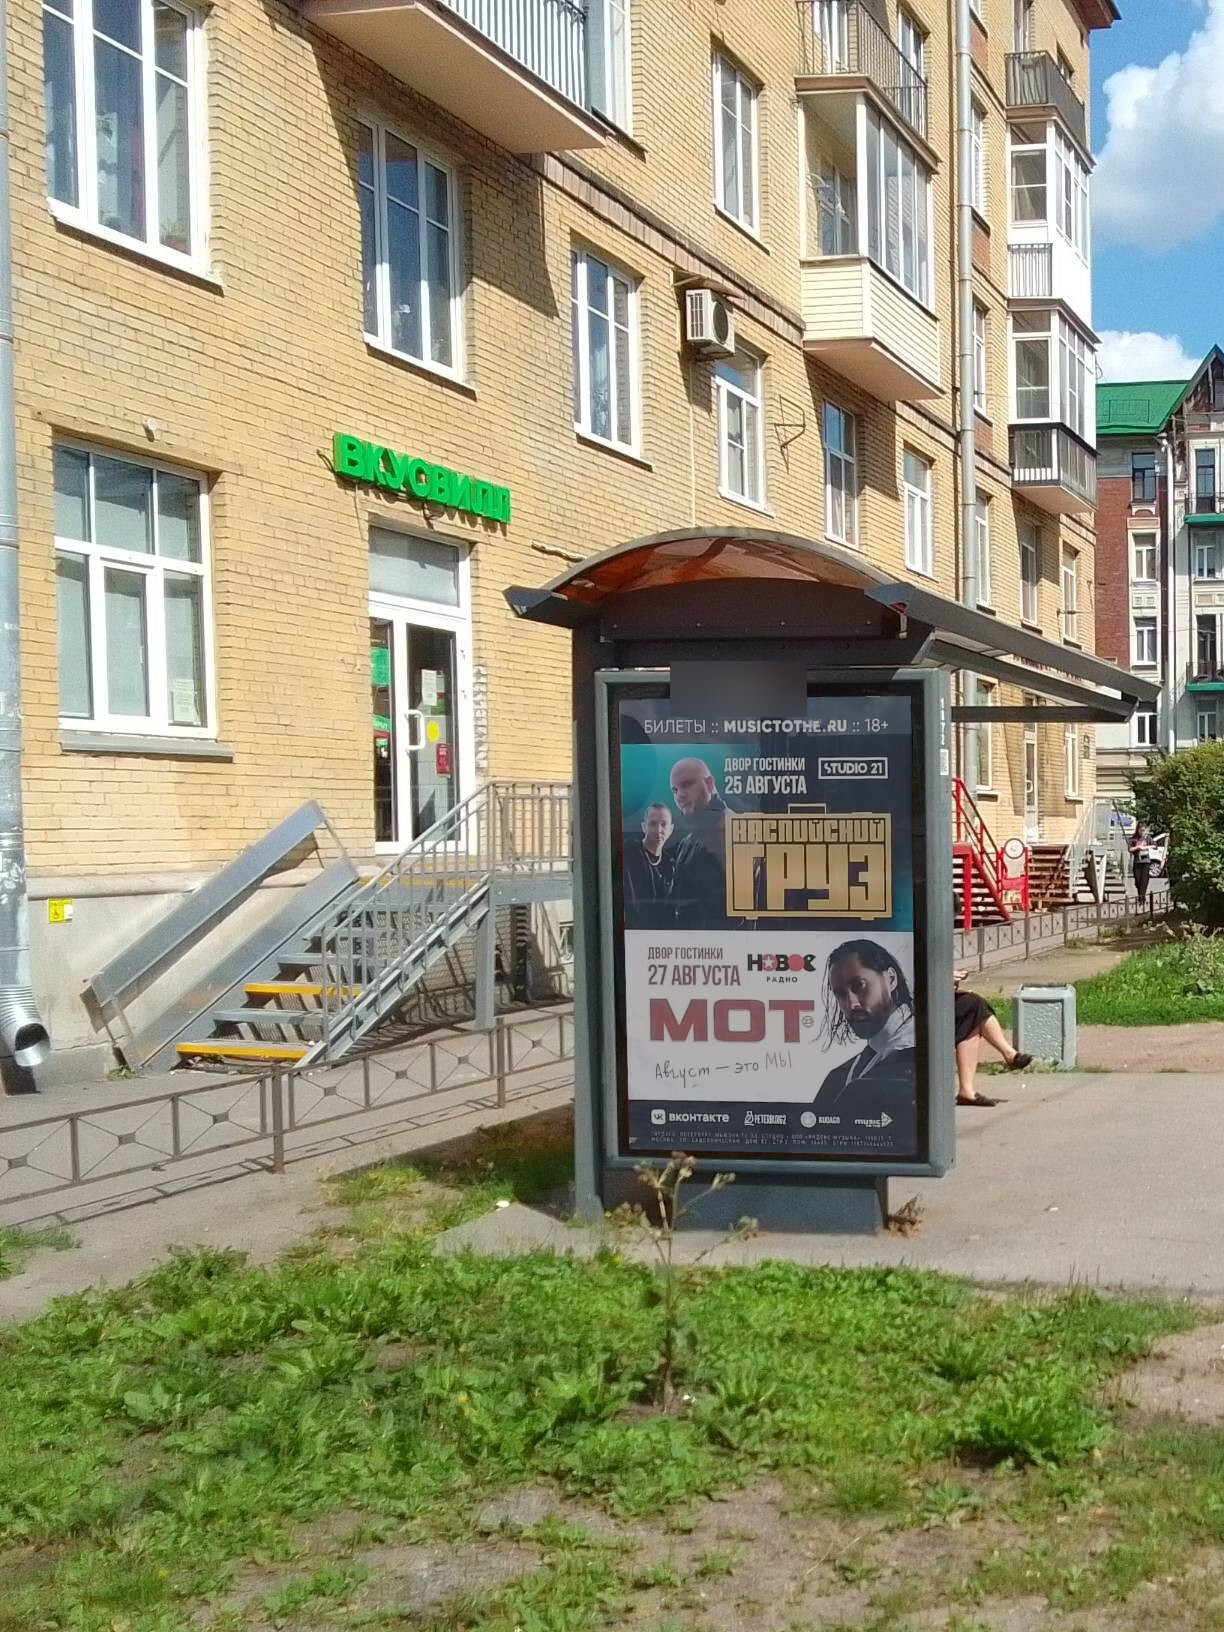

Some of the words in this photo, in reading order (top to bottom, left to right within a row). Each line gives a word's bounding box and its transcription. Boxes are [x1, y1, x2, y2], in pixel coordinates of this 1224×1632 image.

[333, 432, 511, 524] ВКУСВИЛЛ
[644, 719, 706, 734] БИЛЕТЫ
[724, 719, 848, 733] MUSICTOTHE.RU
[865, 718, 889, 732] 18+
[724, 757, 751, 772] ДВОР
[753, 757, 806, 772] ГОСТИНКИ
[823, 762, 868, 774] STUDIO
[870, 762, 883, 774] 21
[725, 775, 742, 795] 25
[745, 775, 808, 795] АВГУСТА
[732, 819, 885, 842] КАСПИЙСКИЙ
[733, 844, 885, 911] ГРУЗ
[648, 946, 673, 960] ДВОР
[675, 947, 723, 960] ГОСТИНКИ
[648, 964, 668, 985] 27
[671, 965, 741, 986] АВГУСТА
[766, 976, 798, 984] РАДИО
[649, 998, 815, 1043] МОТ
[655, 1060, 710, 1088] Август
[733, 1062, 759, 1074] это
[765, 1051, 792, 1069] МЫ
[668, 1112, 730, 1123] вконтакте
